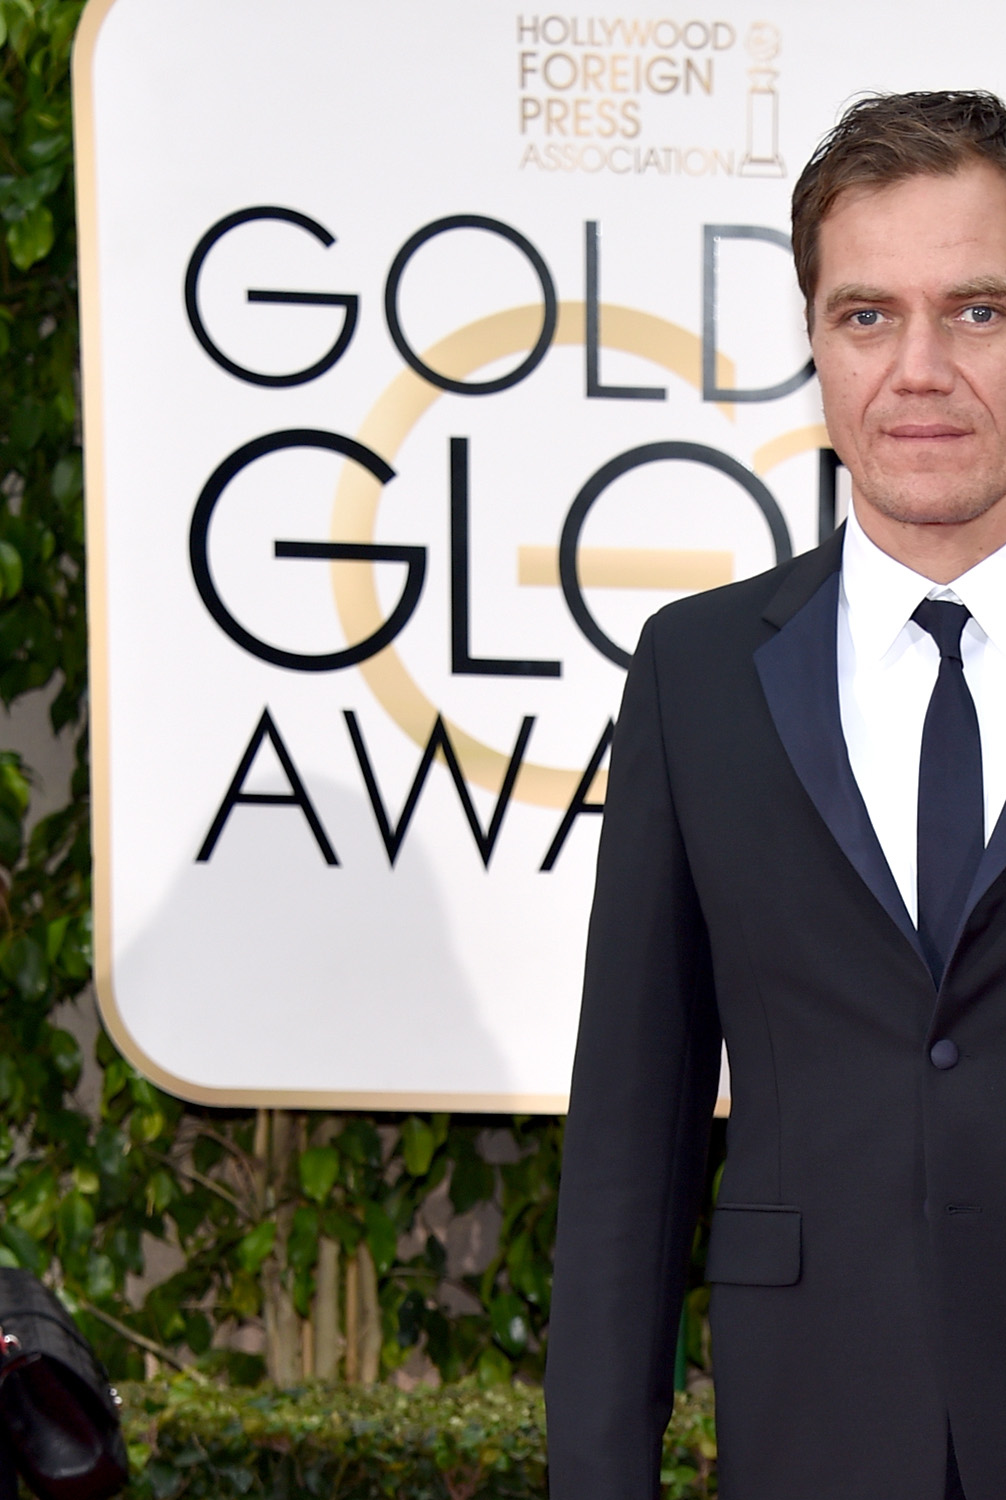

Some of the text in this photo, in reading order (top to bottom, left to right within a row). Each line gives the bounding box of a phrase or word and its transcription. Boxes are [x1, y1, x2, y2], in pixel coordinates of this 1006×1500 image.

[516, 14, 737, 51] HOLLYWOOD
[518, 51, 715, 96] FOREIGN
[519, 97, 642, 139] PRESS
[519, 142, 735, 177] ASSOCIATION
